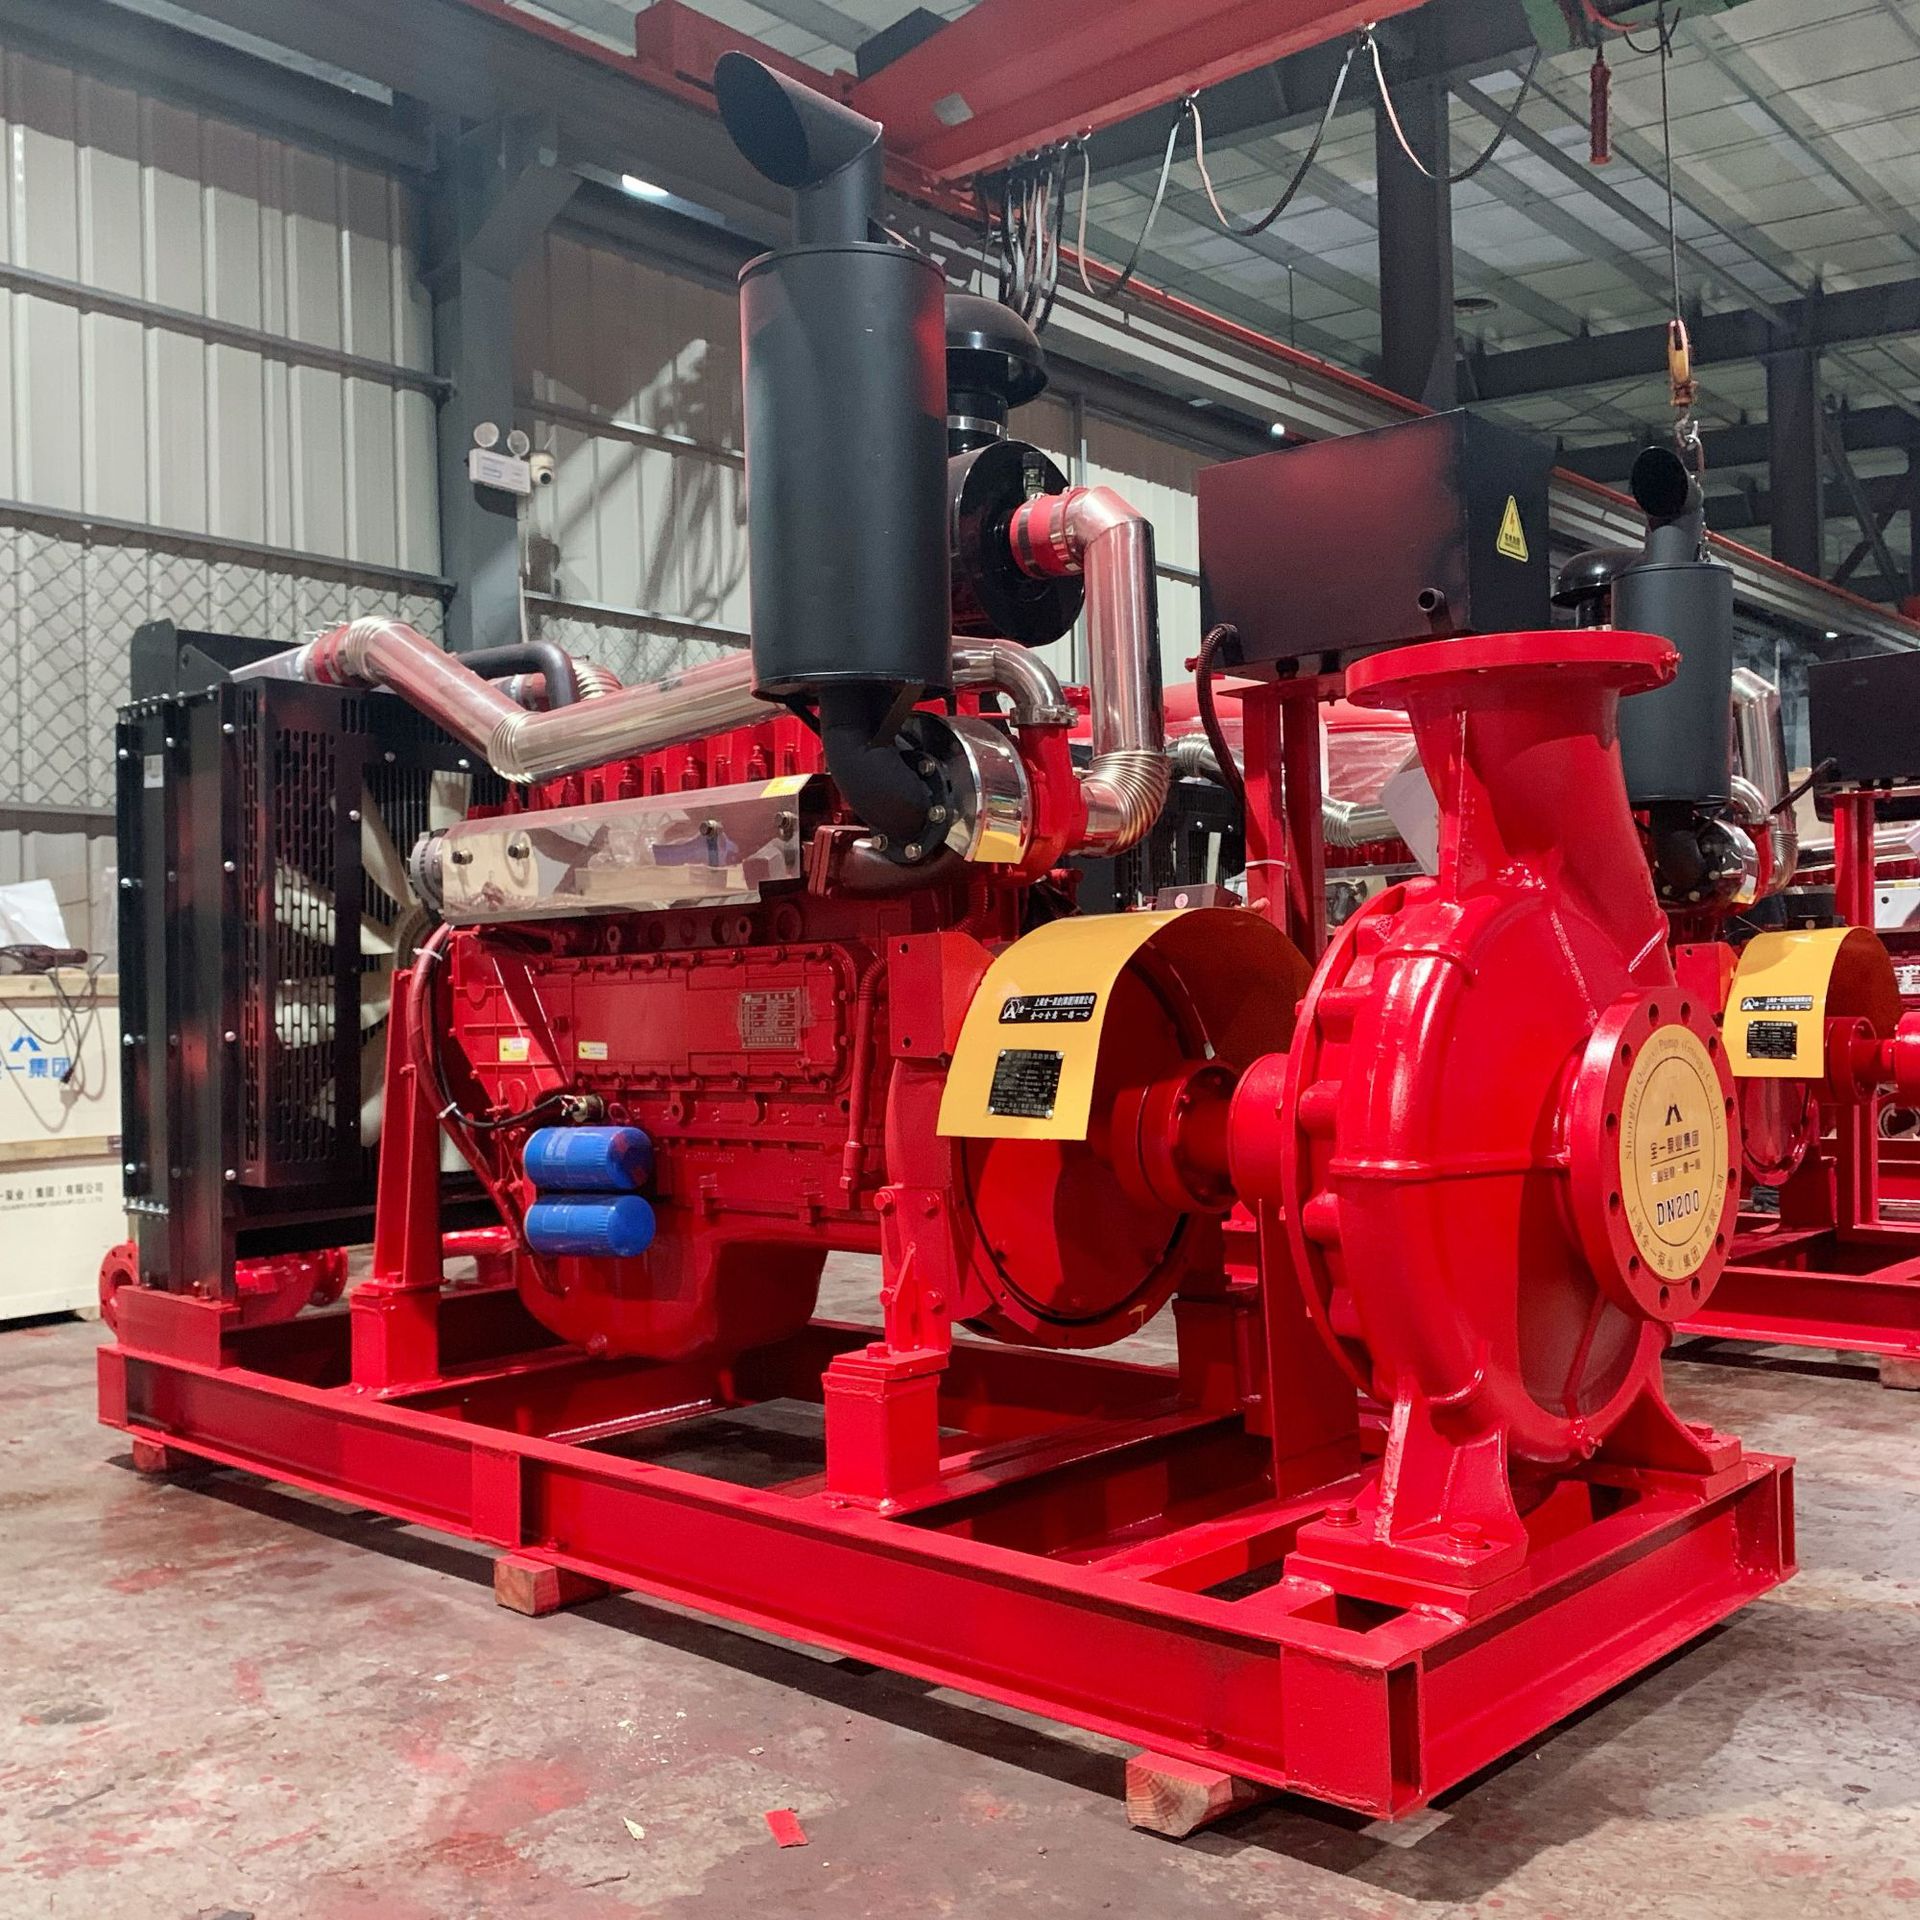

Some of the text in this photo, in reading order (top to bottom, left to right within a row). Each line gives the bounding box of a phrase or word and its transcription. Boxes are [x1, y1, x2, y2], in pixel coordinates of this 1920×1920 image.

[0, 1057, 72, 1080] 一集团
[1656, 1190, 1700, 1226] DN200
